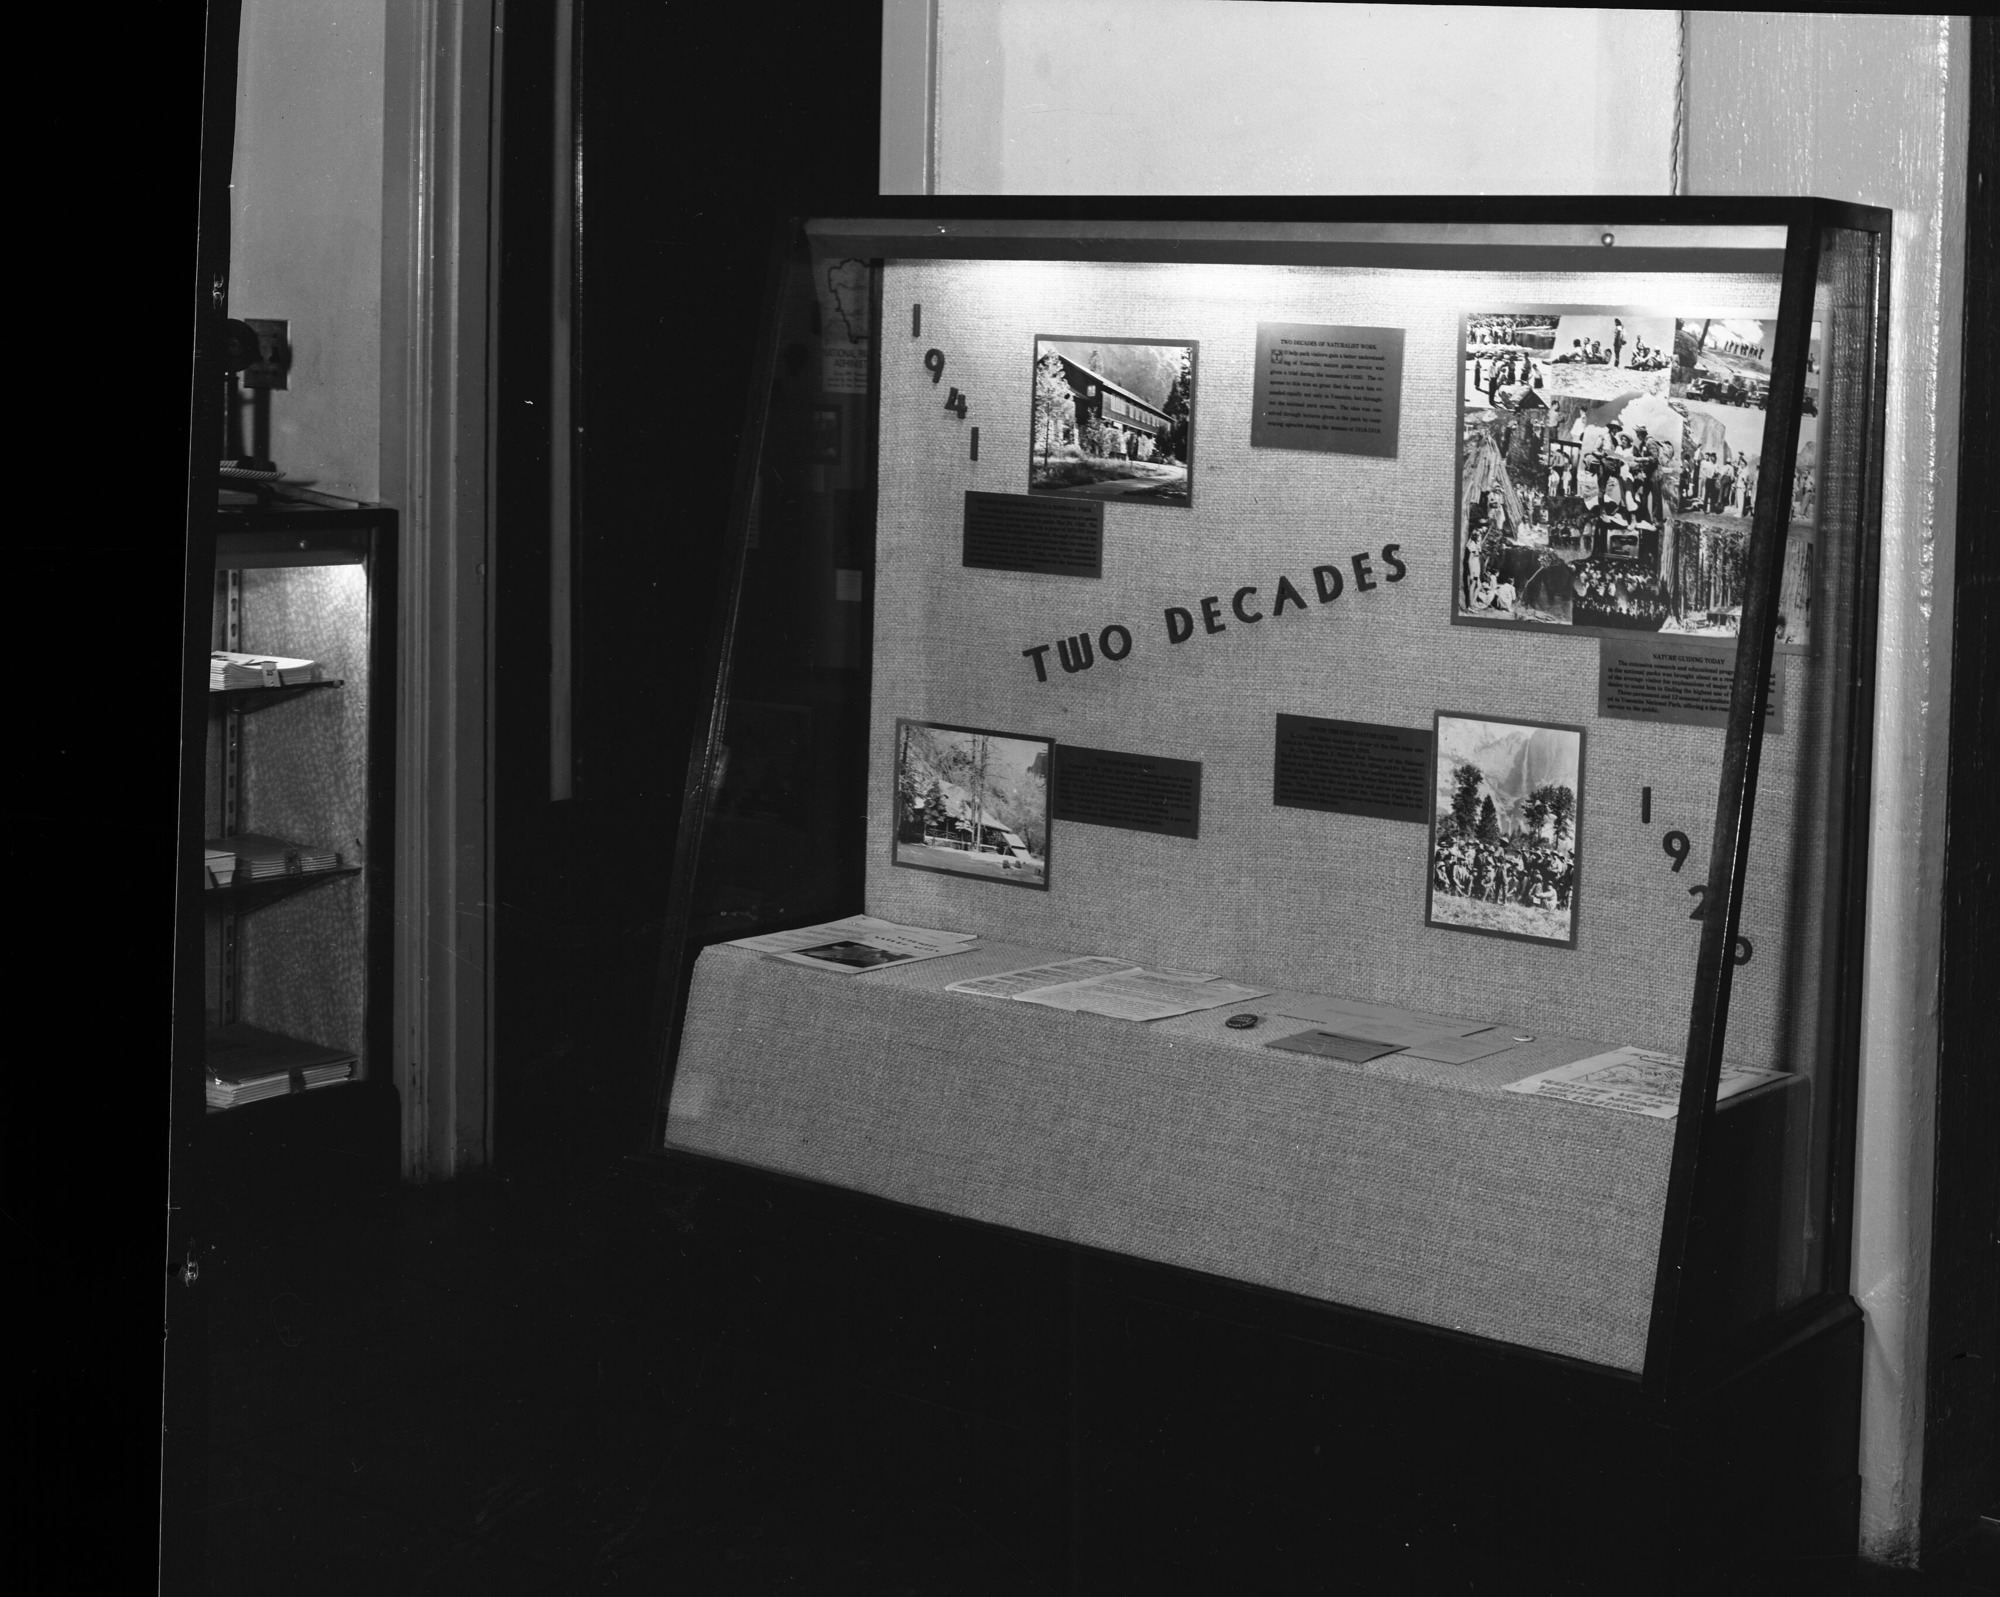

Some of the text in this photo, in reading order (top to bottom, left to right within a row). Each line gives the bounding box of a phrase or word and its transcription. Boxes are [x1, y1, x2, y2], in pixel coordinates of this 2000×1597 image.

[1293, 339, 1317, 347] DECADES
[912, 303, 979, 462] 1941
[1022, 543, 1406, 682] TWO DECADES
[1653, 654, 1725, 665] NATURE GUIDING TODAY
[1654, 663, 1676, 671] research
[1688, 666, 1718, 674] educational
